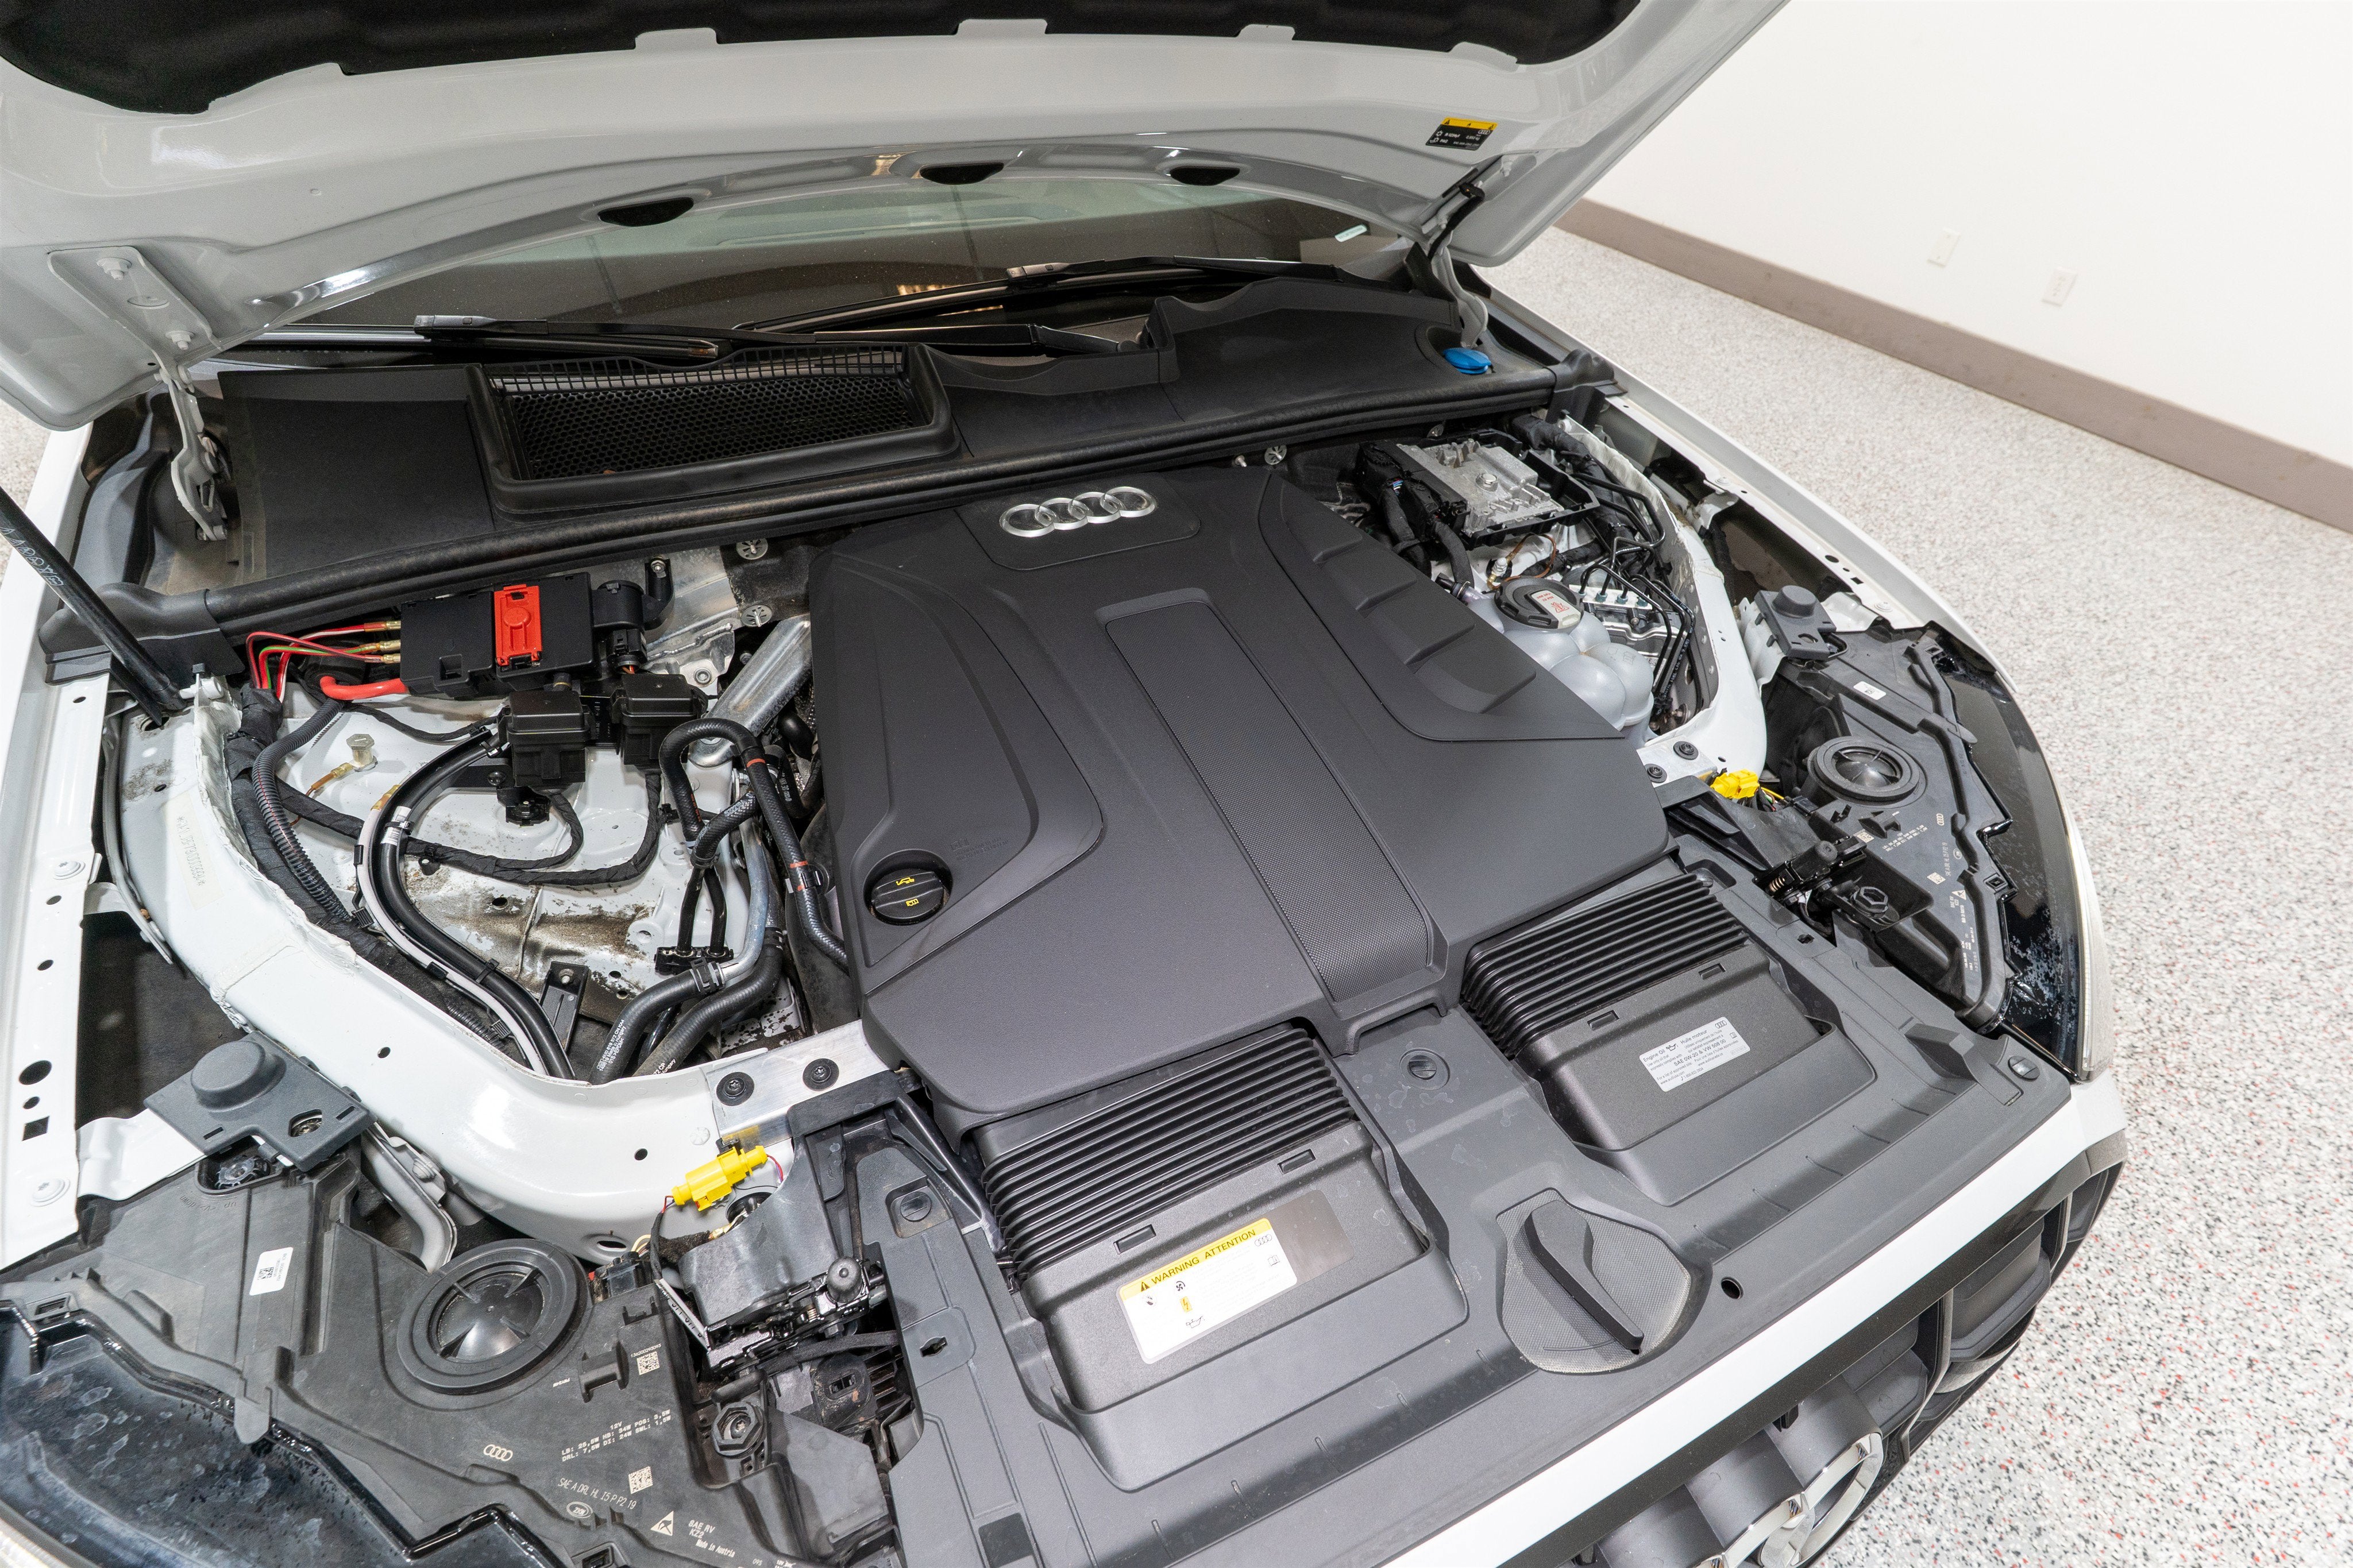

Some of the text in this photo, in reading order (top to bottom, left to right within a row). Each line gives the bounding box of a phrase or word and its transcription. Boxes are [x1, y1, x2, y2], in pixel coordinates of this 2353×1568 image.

[1692, 1030, 1707, 1038] moteur
[1644, 1053, 1658, 1061] Engine
[1684, 1052, 1698, 1060] 0W-20
[1151, 1230, 1256, 1284] WARNING ATTENTION
[610, 1422, 622, 1430] 12V
[618, 1424, 631, 1434] 34W
[619, 1430, 632, 1439] 24W
[557, 1478, 572, 1489] SAE
[572, 1482, 578, 1490] A
[578, 1484, 588, 1495] DRL
[592, 1487, 599, 1497] HL
[610, 1492, 616, 1503] P
[616, 1496, 627, 1507] P2
[628, 1500, 637, 1509] 19
[689, 1529, 704, 1539] KZ2
[696, 1539, 709, 1548] Made
[709, 1543, 716, 1551] in
